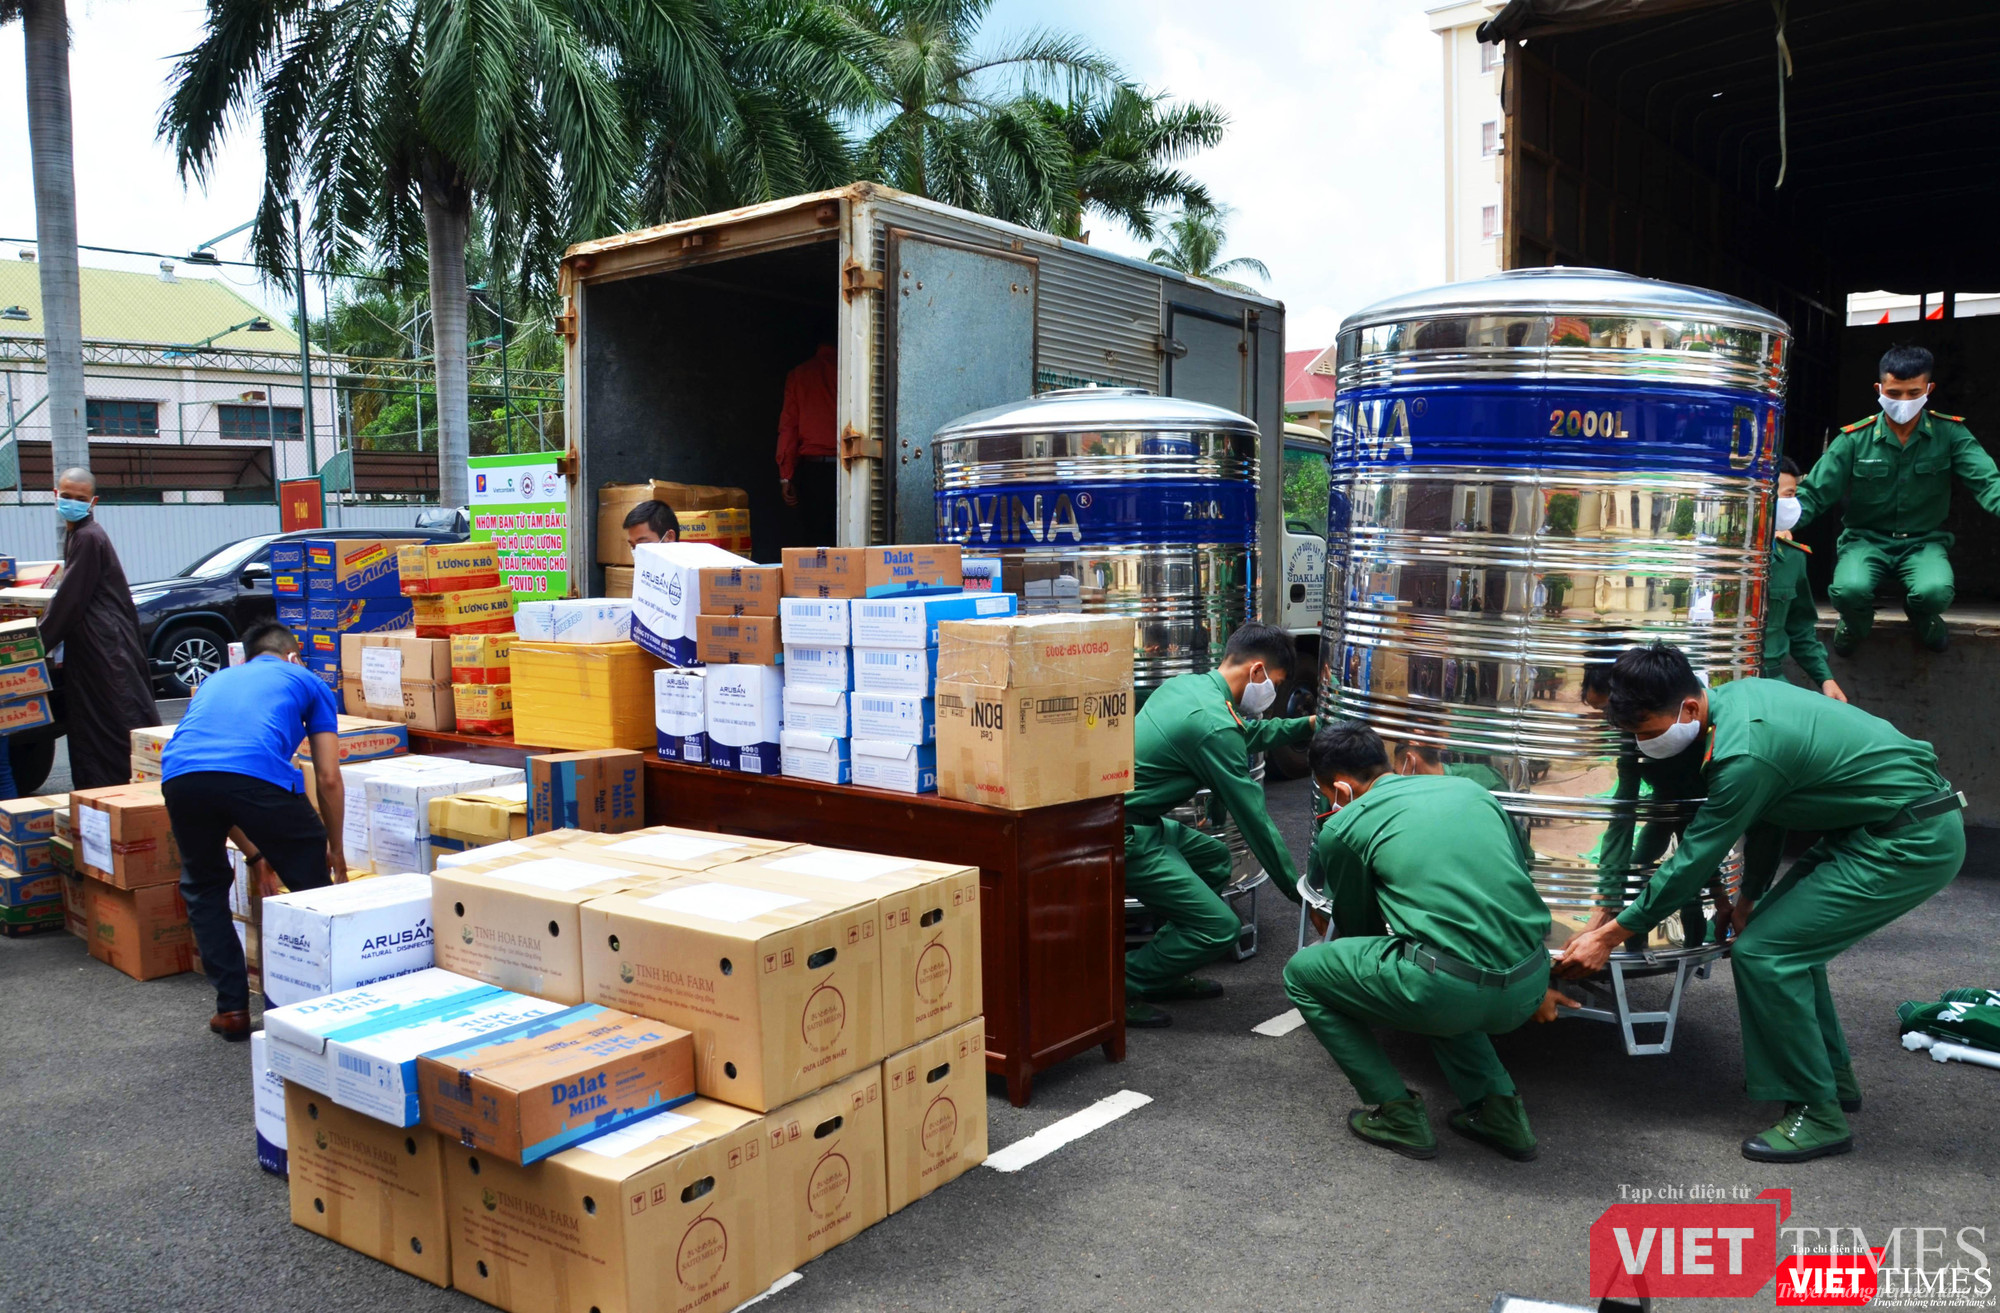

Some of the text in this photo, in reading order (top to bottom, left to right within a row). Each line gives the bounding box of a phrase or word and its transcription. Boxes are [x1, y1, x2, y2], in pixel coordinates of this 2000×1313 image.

[1550, 409, 1629, 439] 2000L
[475, 513, 497, 530] NHÓM
[499, 515, 514, 532] BẠN
[528, 512, 543, 528] TÂM
[508, 533, 562, 553] HỘ LỰC LƯỢNG
[437, 555, 492, 570] LƯƠNG KHÔ
[521, 554, 547, 571] PHÒNG
[883, 551, 914, 565] Dalat
[892, 566, 915, 577] Milk
[508, 576, 547, 592] COVID 19
[979, 578, 992, 590] 304
[458, 603, 489, 614] LƯƠNG
[491, 599, 508, 610] KHÔ
[495, 648, 509, 658] LƯ
[970, 700, 1003, 730] BON!
[1098, 692, 1127, 719] BON!
[612, 785, 622, 819] Milk
[624, 768, 636, 818] Dalat
[474, 926, 541, 951] TINH HOA FARM
[361, 949, 392, 960] NATURAL
[635, 963, 715, 993] TINH HOA FARM
[296, 991, 375, 1014] Dalat
[333, 996, 388, 1013] Milk
[456, 1010, 510, 1028] Milk
[467, 1009, 547, 1033] Dalat
[578, 1034, 630, 1051] Milk
[592, 1032, 663, 1057] Dalat
[551, 1071, 608, 1105] Dalat
[568, 1093, 609, 1118] Milk
[497, 1190, 579, 1232] TINH HOA FARM
